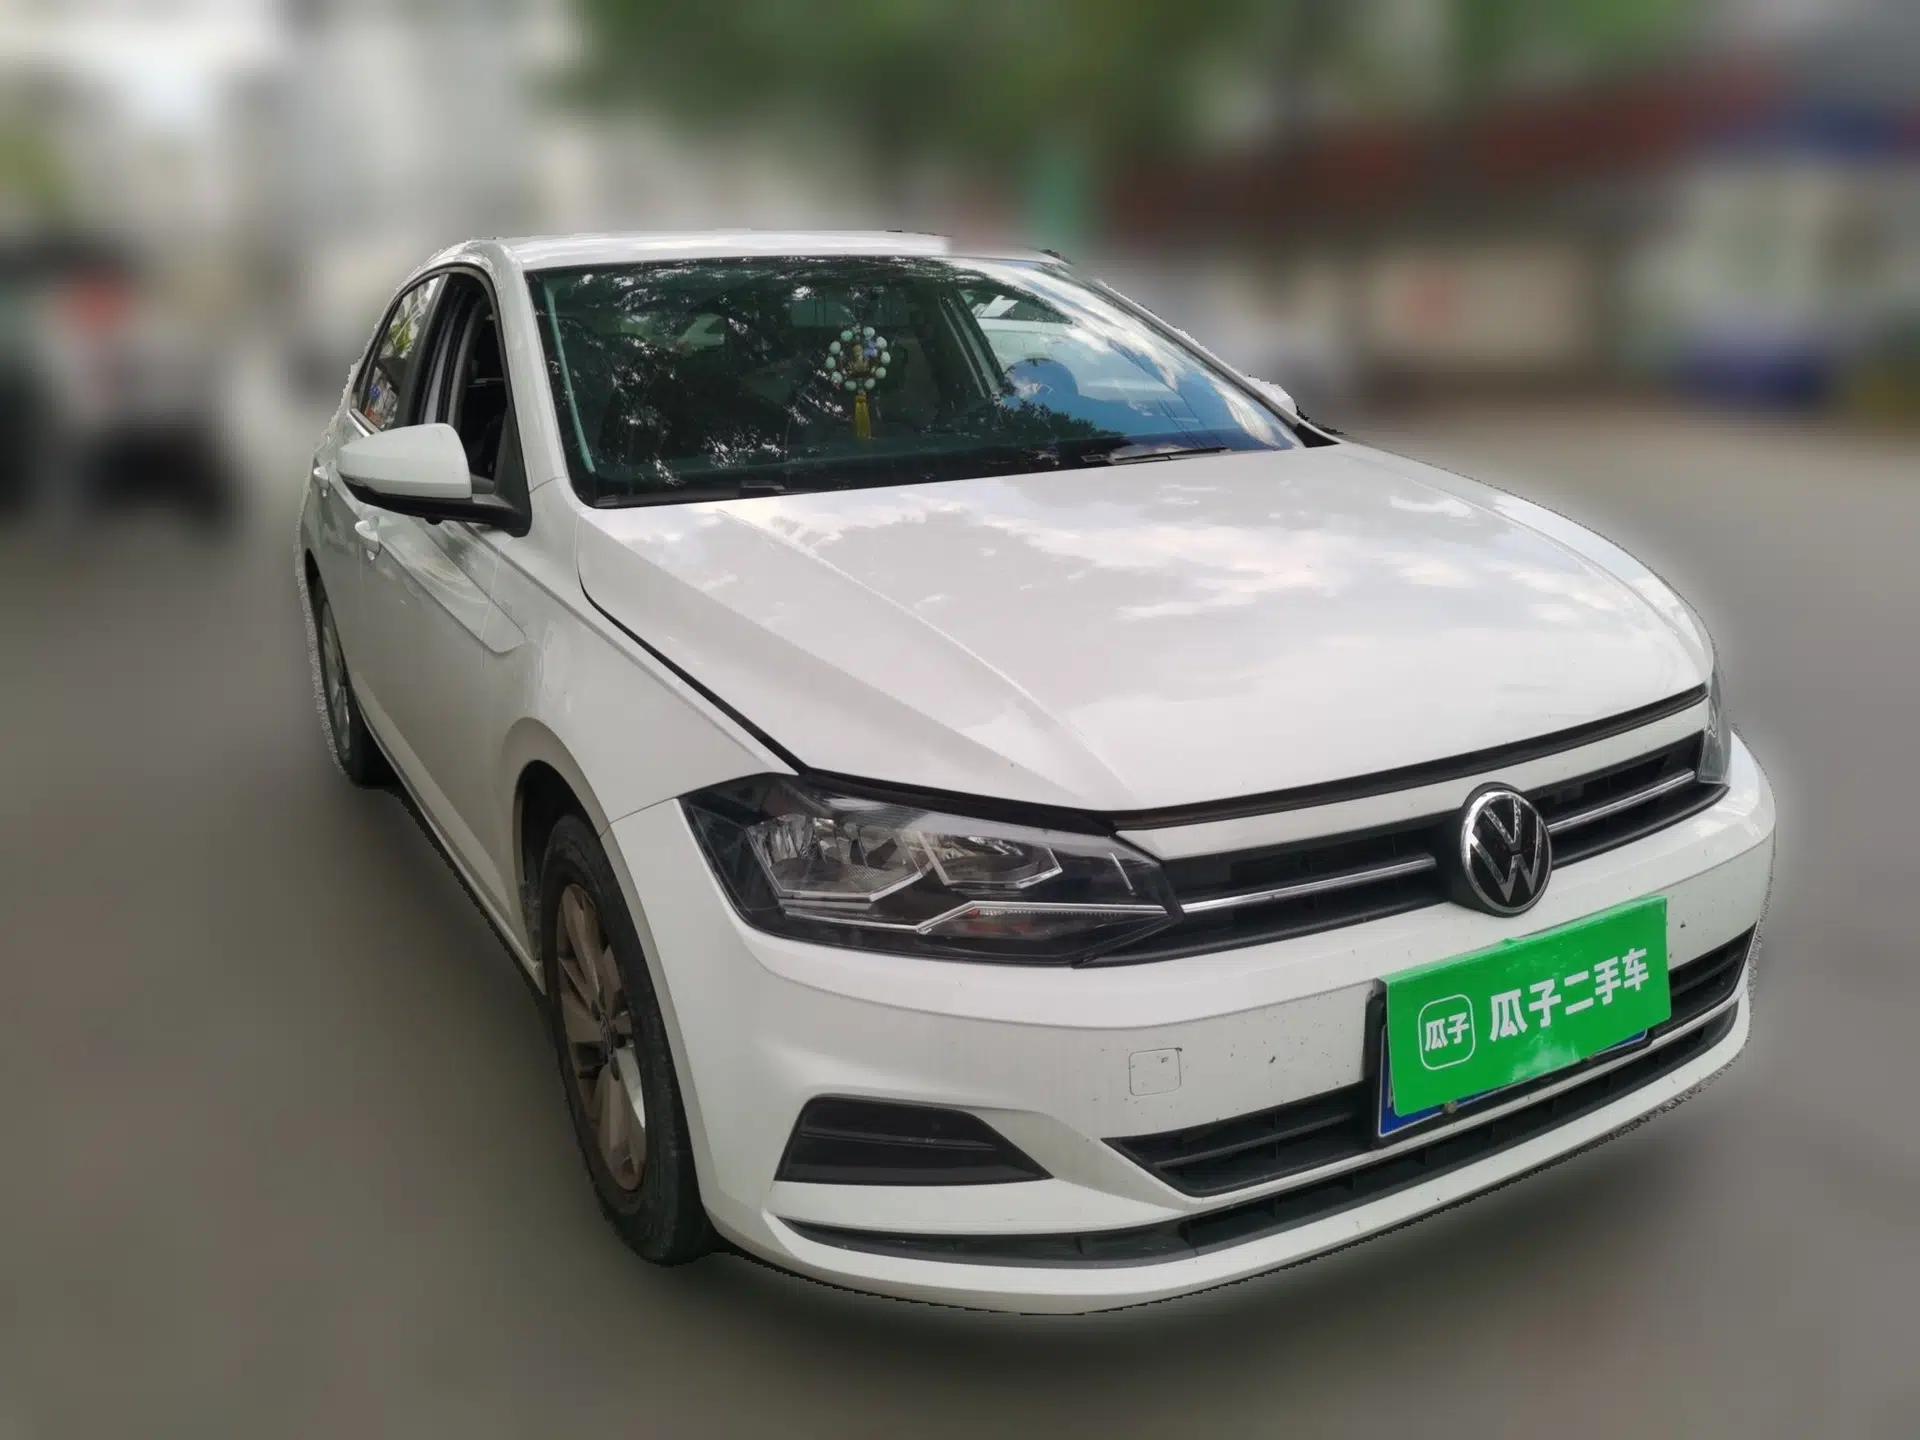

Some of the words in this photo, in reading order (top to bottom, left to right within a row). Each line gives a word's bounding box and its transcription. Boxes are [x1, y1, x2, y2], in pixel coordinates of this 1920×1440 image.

[1489, 947, 1650, 1042] 瓜子二手车
[1424, 1012, 1470, 1052] 瓜子
